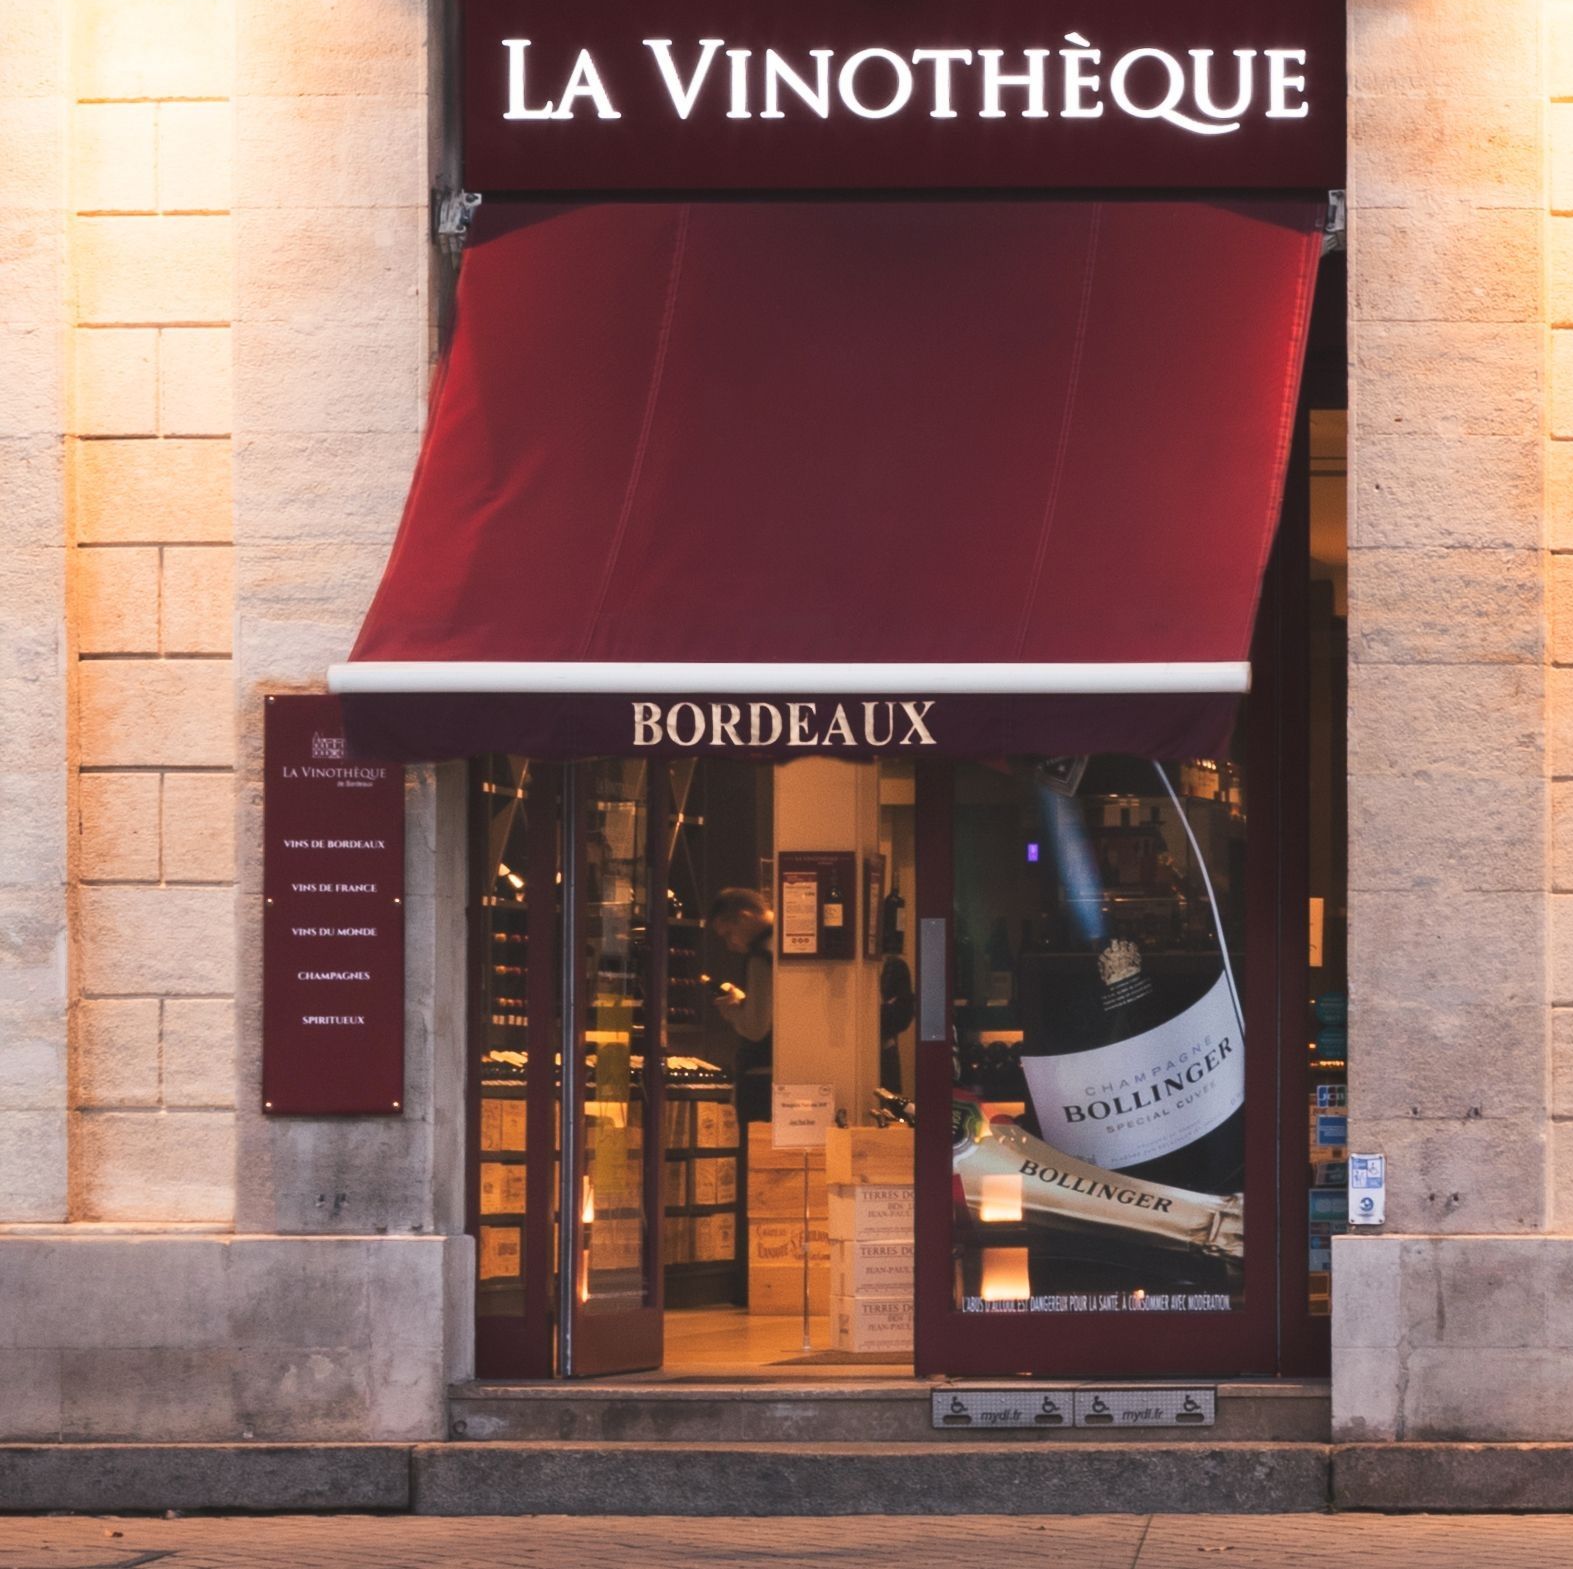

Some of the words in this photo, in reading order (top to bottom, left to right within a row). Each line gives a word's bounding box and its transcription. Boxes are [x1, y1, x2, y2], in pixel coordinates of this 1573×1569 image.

[502, 38, 621, 121] LA
[643, 31, 1310, 135] VINOTHÈQUE
[631, 700, 937, 747] BORDEAUX
[284, 839, 309, 848] VINS
[311, 839, 324, 849] DE
[327, 839, 385, 849] BORDEAUX
[292, 883, 317, 892] VINS
[319, 883, 332, 892] DE
[335, 883, 377, 892] FRANCE
[292, 927, 317, 936] VINS
[319, 927, 335, 936] DU
[337, 927, 377, 936] MONDE
[297, 971, 372, 981] CHAMPAGNES
[302, 1015, 366, 1025] SPIRITUEUX
[1084, 1034, 1213, 1097] CHAMPAGNE
[1062, 1036, 1233, 1124] BOLLINGER
[1106, 1109, 1170, 1134] SPECIAL
[1018, 1158, 1174, 1214] BOLLINGER
[1030, 1295, 1068, 1312] DANGEREUX
[1069, 1293, 1087, 1312] POUR
[1089, 1295, 1098, 1312] LA
[1171, 1294, 1186, 1311] AVEC
